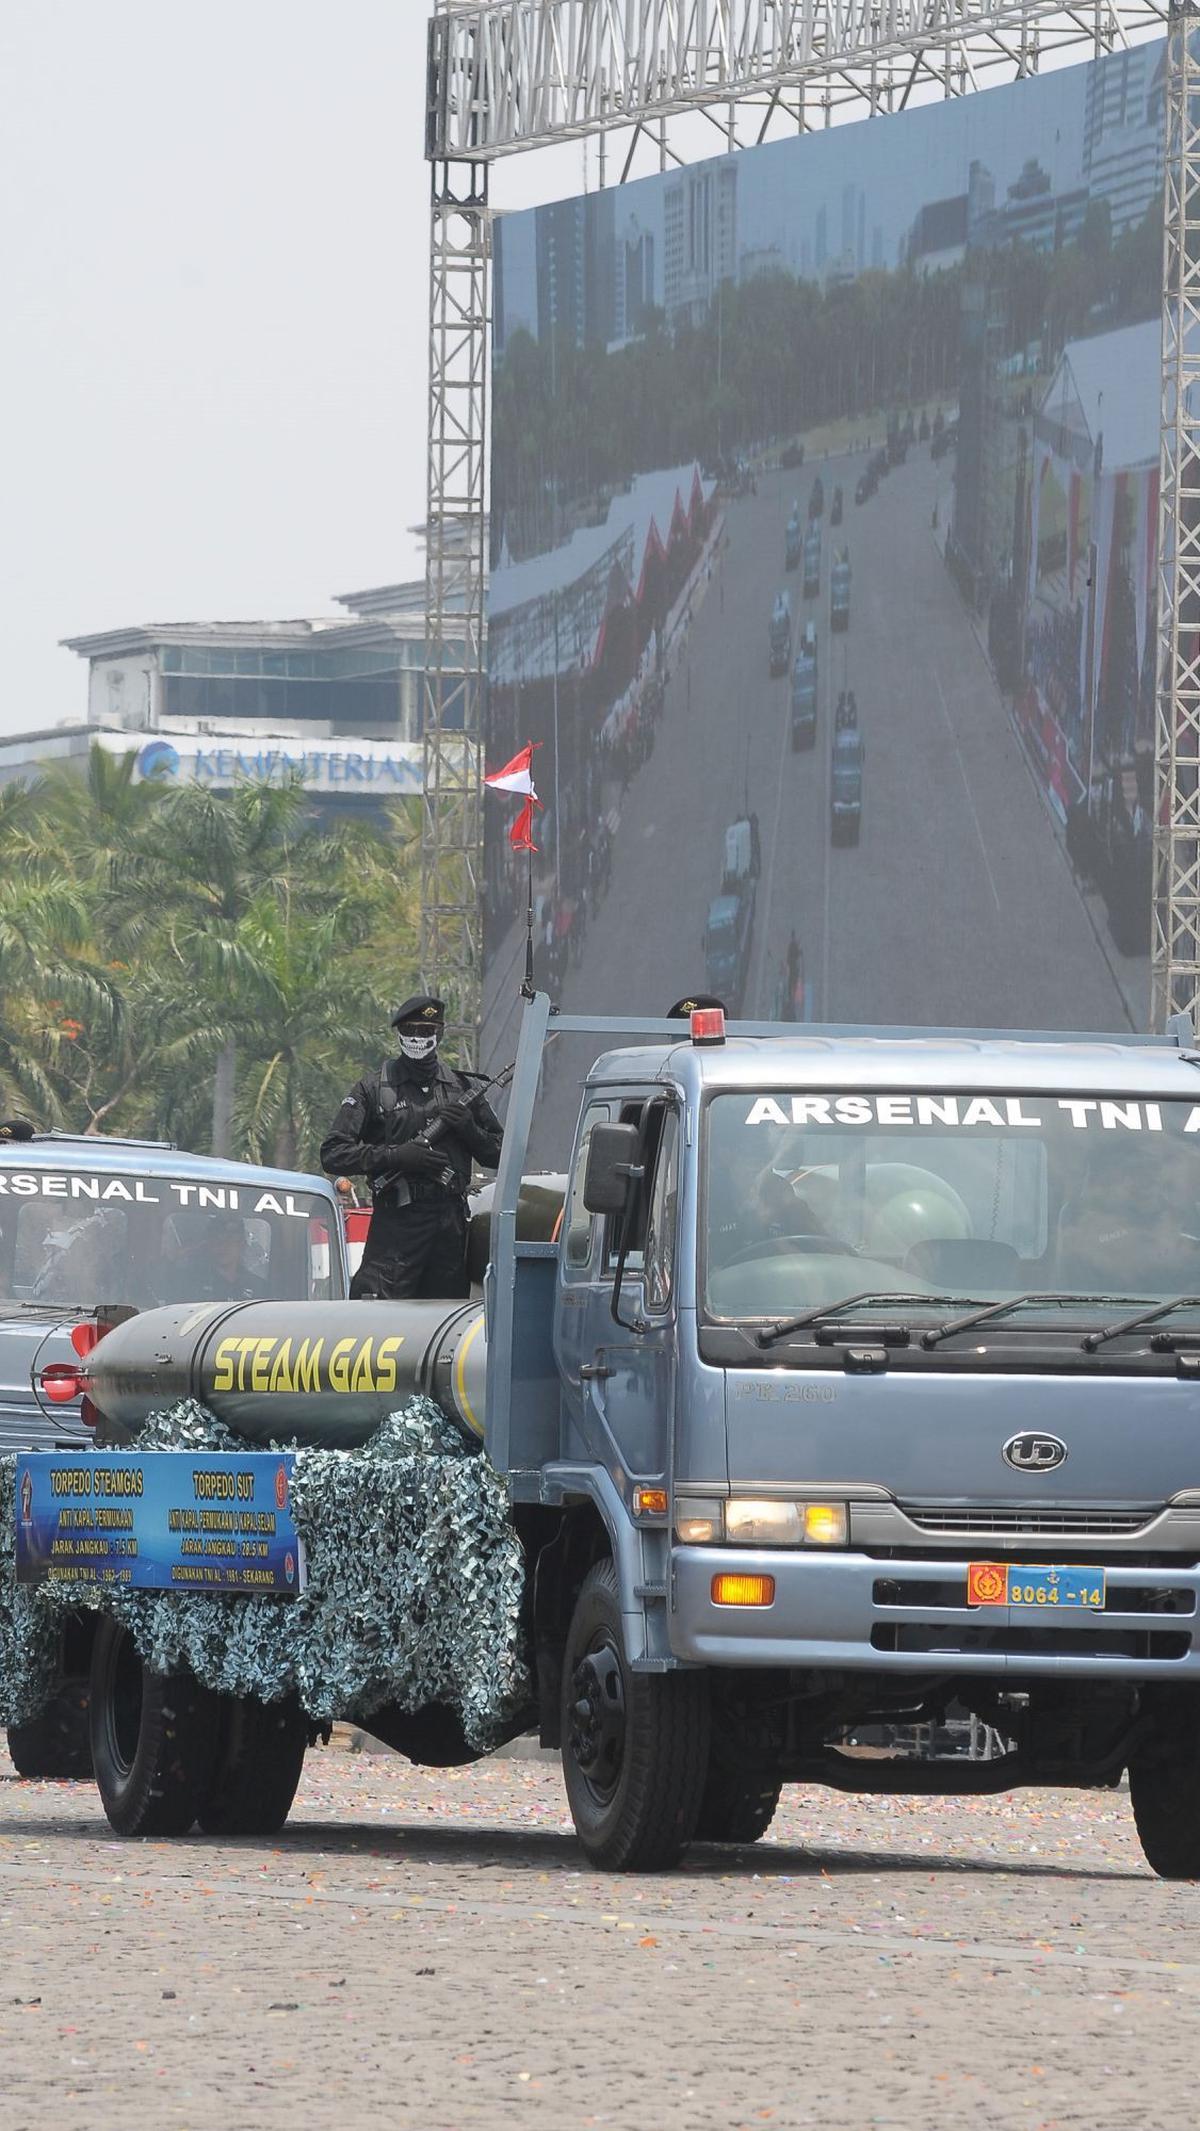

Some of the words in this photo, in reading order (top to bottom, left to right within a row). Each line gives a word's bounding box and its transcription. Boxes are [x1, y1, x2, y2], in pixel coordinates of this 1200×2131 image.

[745, 1097, 1041, 1127] ARSENAL
[1058, 1100, 1163, 1131] TNI
[170, 1184, 239, 1210] TNI
[254, 1193, 310, 1218] AL
[214, 1337, 325, 1392] STEAM
[328, 1337, 405, 1392] GAS
[783, 1383, 838, 1404] 260
[1012, 1440, 1061, 1465] UD
[50, 1469, 91, 1497] TORPEDO
[94, 1468, 144, 1497] STEAMGAS
[193, 1471, 234, 1500] TORPEDO
[237, 1472, 255, 1501] SUT
[51, 1539, 74, 1556] JARAK
[75, 1539, 109, 1556] JANGKAU
[181, 1539, 202, 1554] JARAK
[204, 1540, 237, 1556] JANGKAU
[1011, 1586, 1059, 1604] 8064
